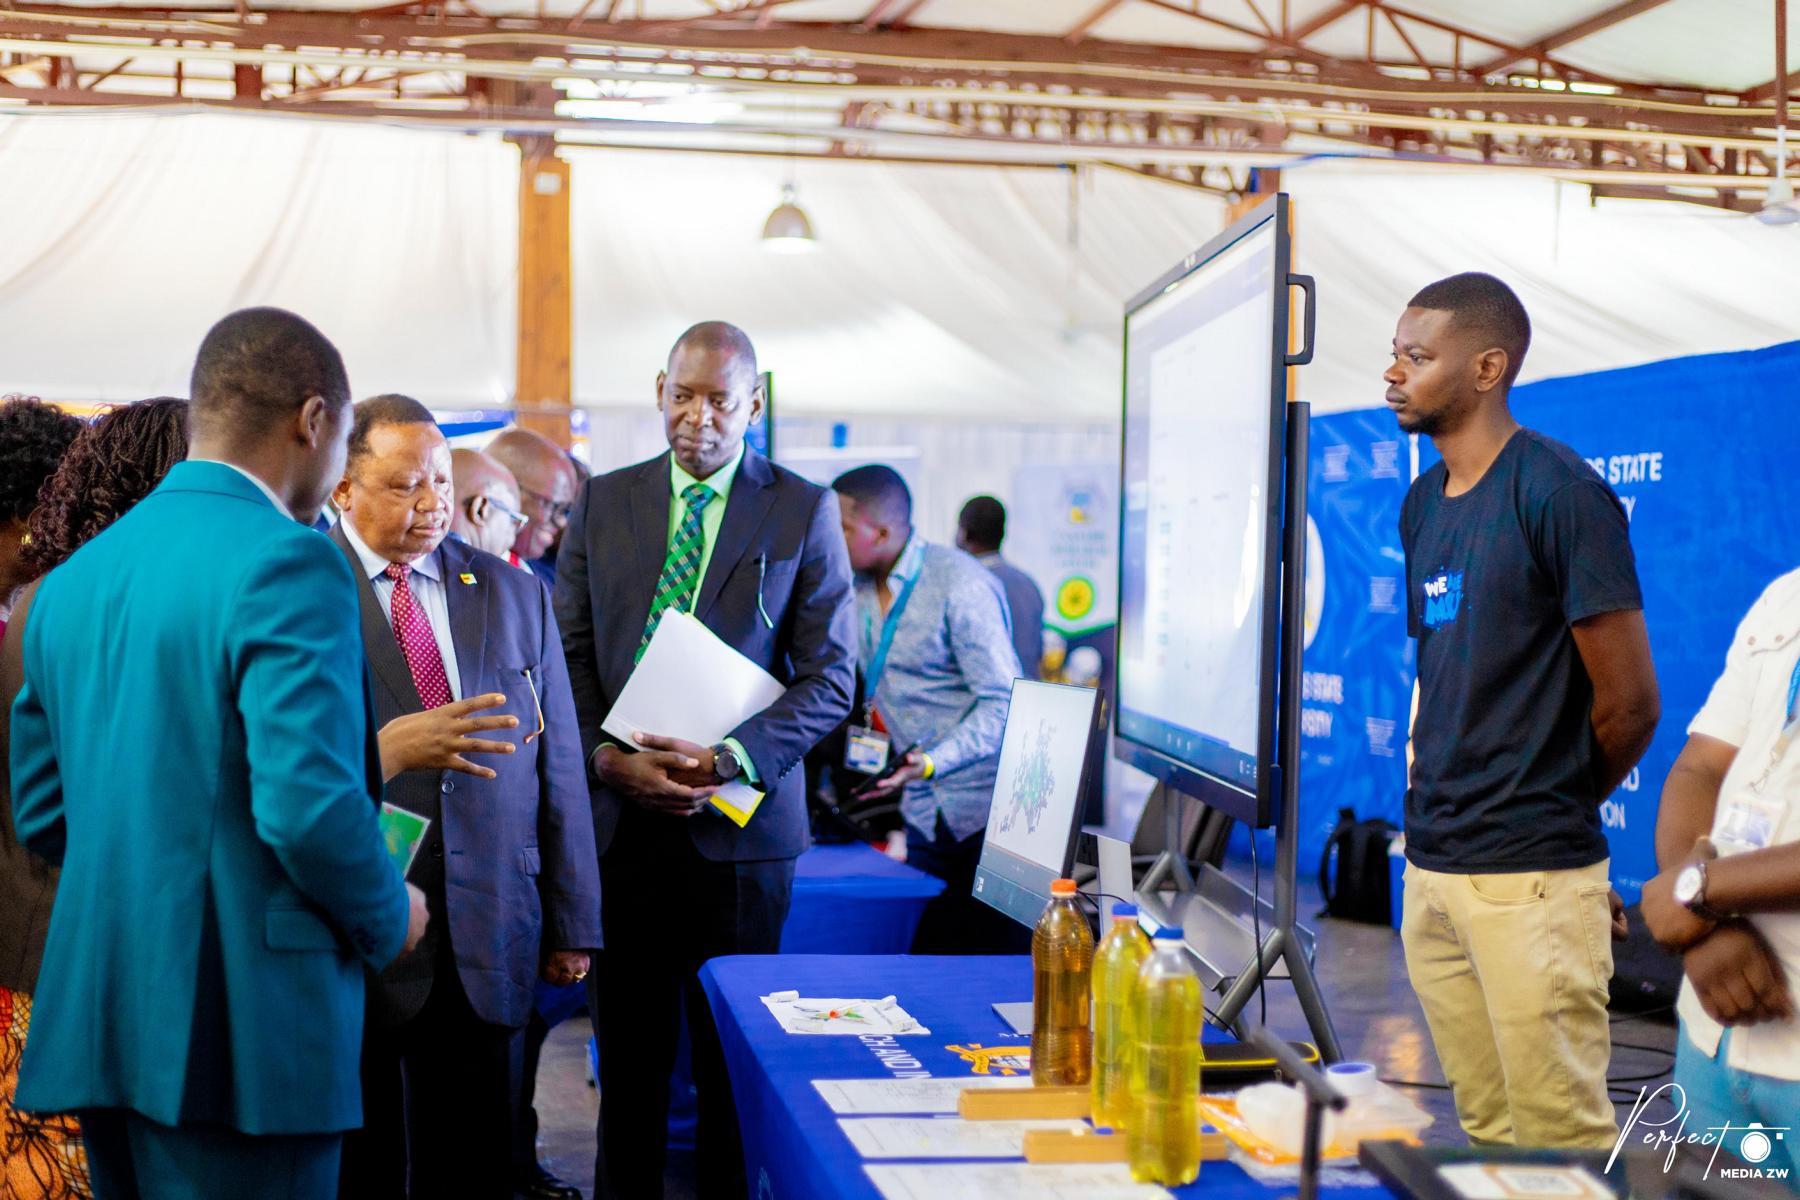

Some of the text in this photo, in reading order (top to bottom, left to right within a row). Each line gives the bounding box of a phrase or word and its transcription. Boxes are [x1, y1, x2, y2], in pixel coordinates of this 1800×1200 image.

[1608, 452, 1663, 485] STATE
[1424, 576, 1448, 598] WE
[870, 1048, 923, 1069] AND
